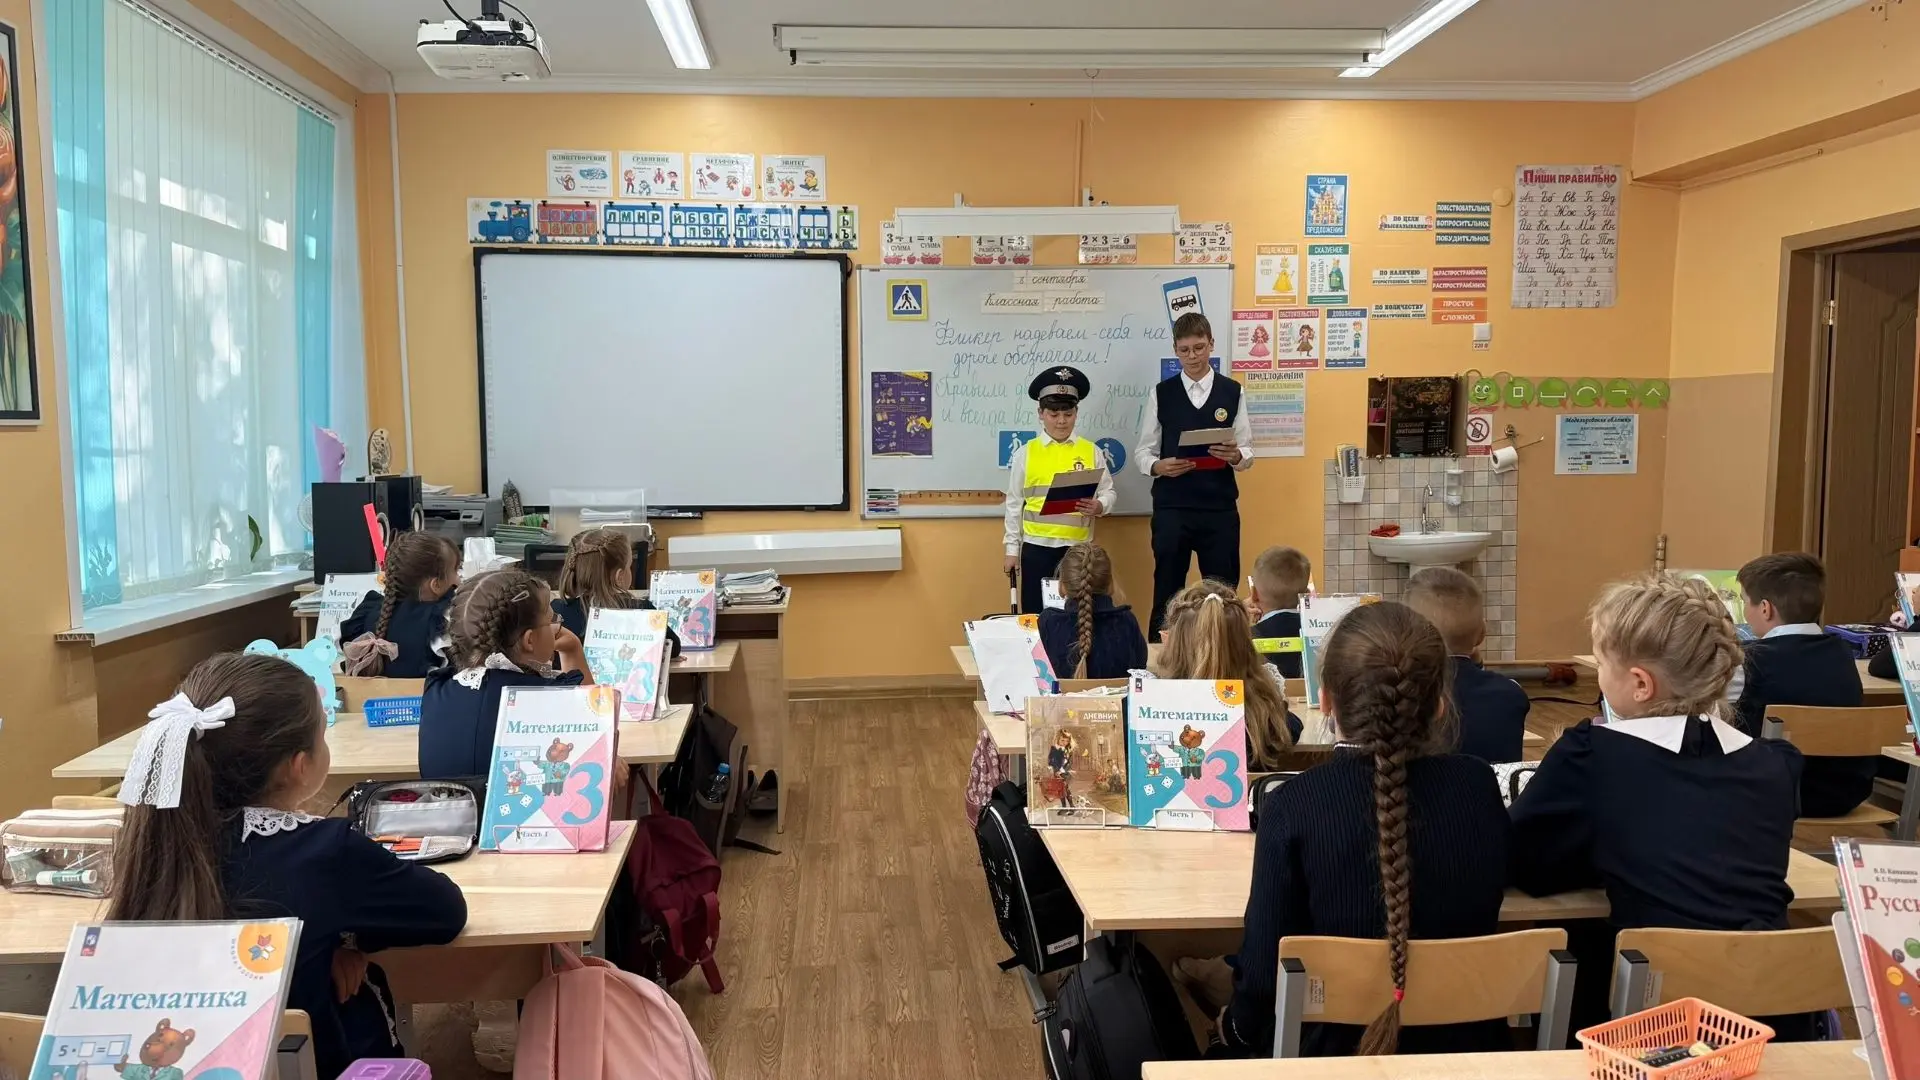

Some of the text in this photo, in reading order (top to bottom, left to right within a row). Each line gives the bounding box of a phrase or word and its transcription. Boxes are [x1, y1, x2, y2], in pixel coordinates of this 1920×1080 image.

[632, 155, 670, 163] СРАВНЕНИЕ
[1317, 177, 1337, 185] СТРАНА
[607, 211, 616, 222] Л
[621, 212, 631, 221] М
[637, 211, 646, 222] Н
[651, 212, 660, 222] Р
[688, 213, 696, 223] Б
[715, 213, 724, 224] Г
[748, 214, 758, 225] Ж
[1436, 219, 1489, 227] ВОПРОСИТЕЛЬНОЕ
[702, 228, 711, 237] Ф
[714, 227, 724, 237] К
[760, 227, 768, 238] С
[772, 227, 780, 239] Х
[886, 233, 893, 243] 3
[976, 235, 983, 246] 4
[1000, 236, 1004, 246] 1
[1081, 234, 1130, 245] 2 3 6
[1179, 236, 1226, 246] 6 3 2
[1314, 246, 1343, 254] СКАЗУЕМОЕ
[1032, 269, 1087, 288] сентября
[984, 291, 1100, 309] Классная работа
[1441, 313, 1476, 321] СЛОЖНОЕ
[1144, 326, 1169, 340] на
[953, 351, 999, 377] дороге
[935, 370, 1008, 406] Правила
[655, 587, 706, 595] Математика
[592, 629, 655, 642] Математика
[626, 661, 655, 702] 3
[1083, 712, 1118, 720] ДНЕВНИК
[1138, 706, 1228, 722] Математика
[506, 720, 599, 734] Математика
[1204, 749, 1244, 809] 3
[560, 762, 604, 825] 3
[70, 984, 248, 1012] Математика
[58, 1044, 68, 1057] 5
